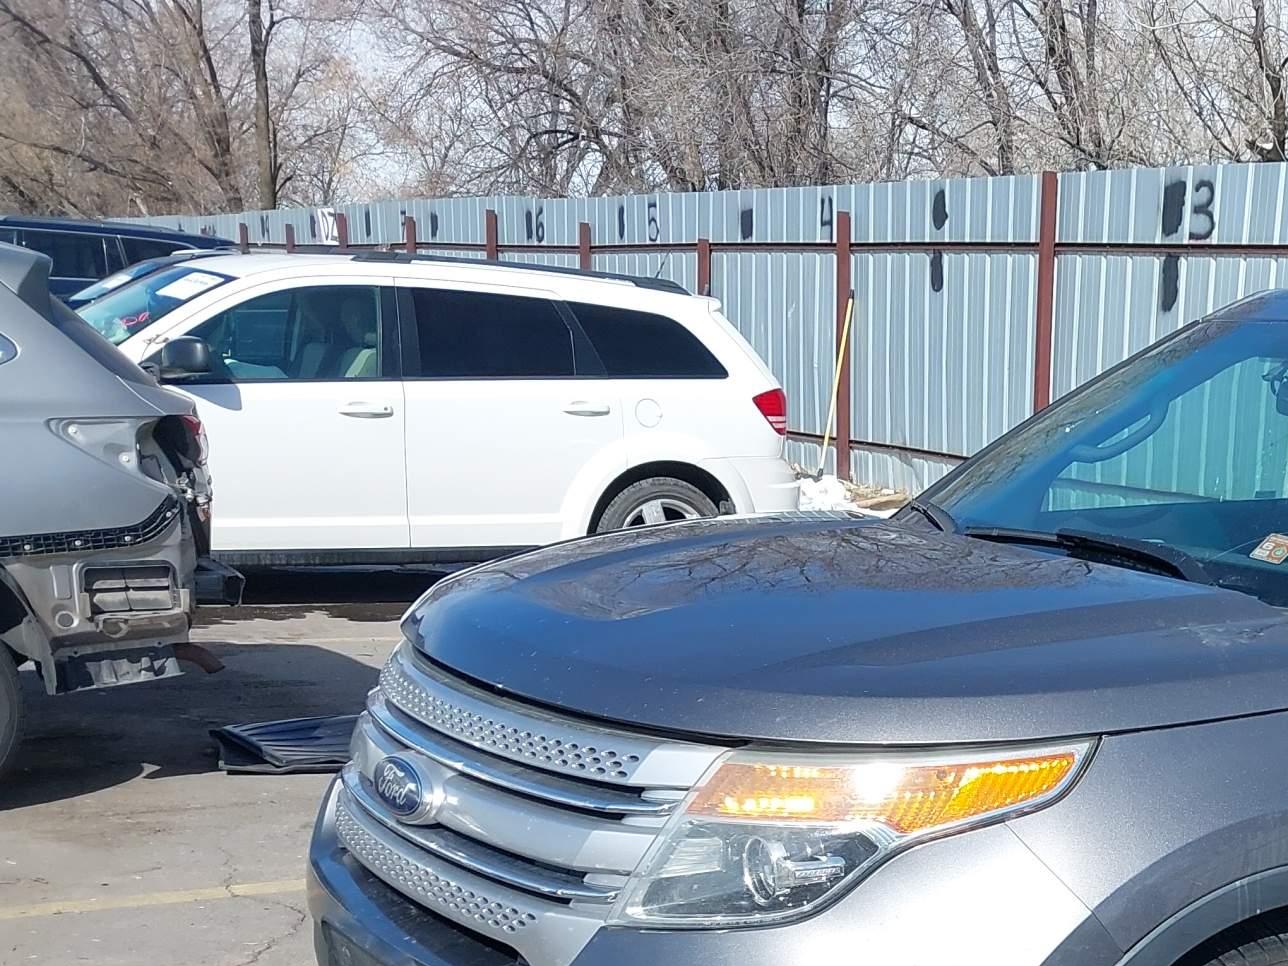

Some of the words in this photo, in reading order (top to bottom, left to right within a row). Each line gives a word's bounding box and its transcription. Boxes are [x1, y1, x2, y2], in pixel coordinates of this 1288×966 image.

[535, 205, 545, 244] 6
[820, 196, 833, 243] 4
[1186, 179, 1216, 241] 3
[378, 763, 418, 806] Ford
